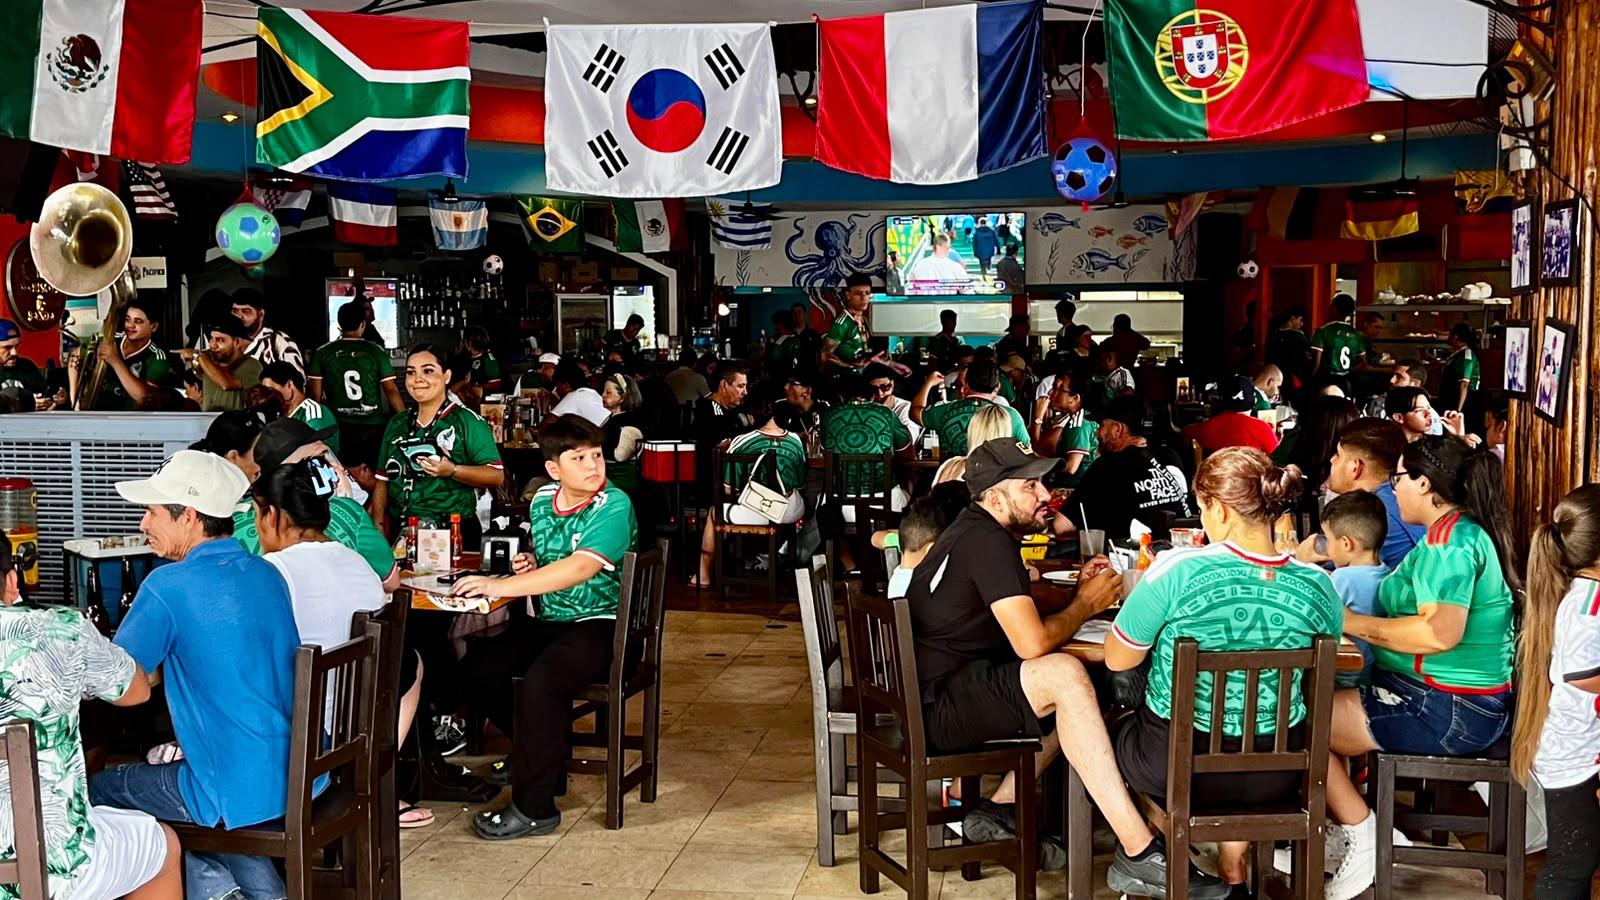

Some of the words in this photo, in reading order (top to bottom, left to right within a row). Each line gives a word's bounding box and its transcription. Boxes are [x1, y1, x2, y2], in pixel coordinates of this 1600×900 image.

[1340, 346, 1350, 369] 6
[344, 370, 363, 400] 6
[1148, 467, 1164, 481] TH
[1150, 486, 1177, 500] FACE
